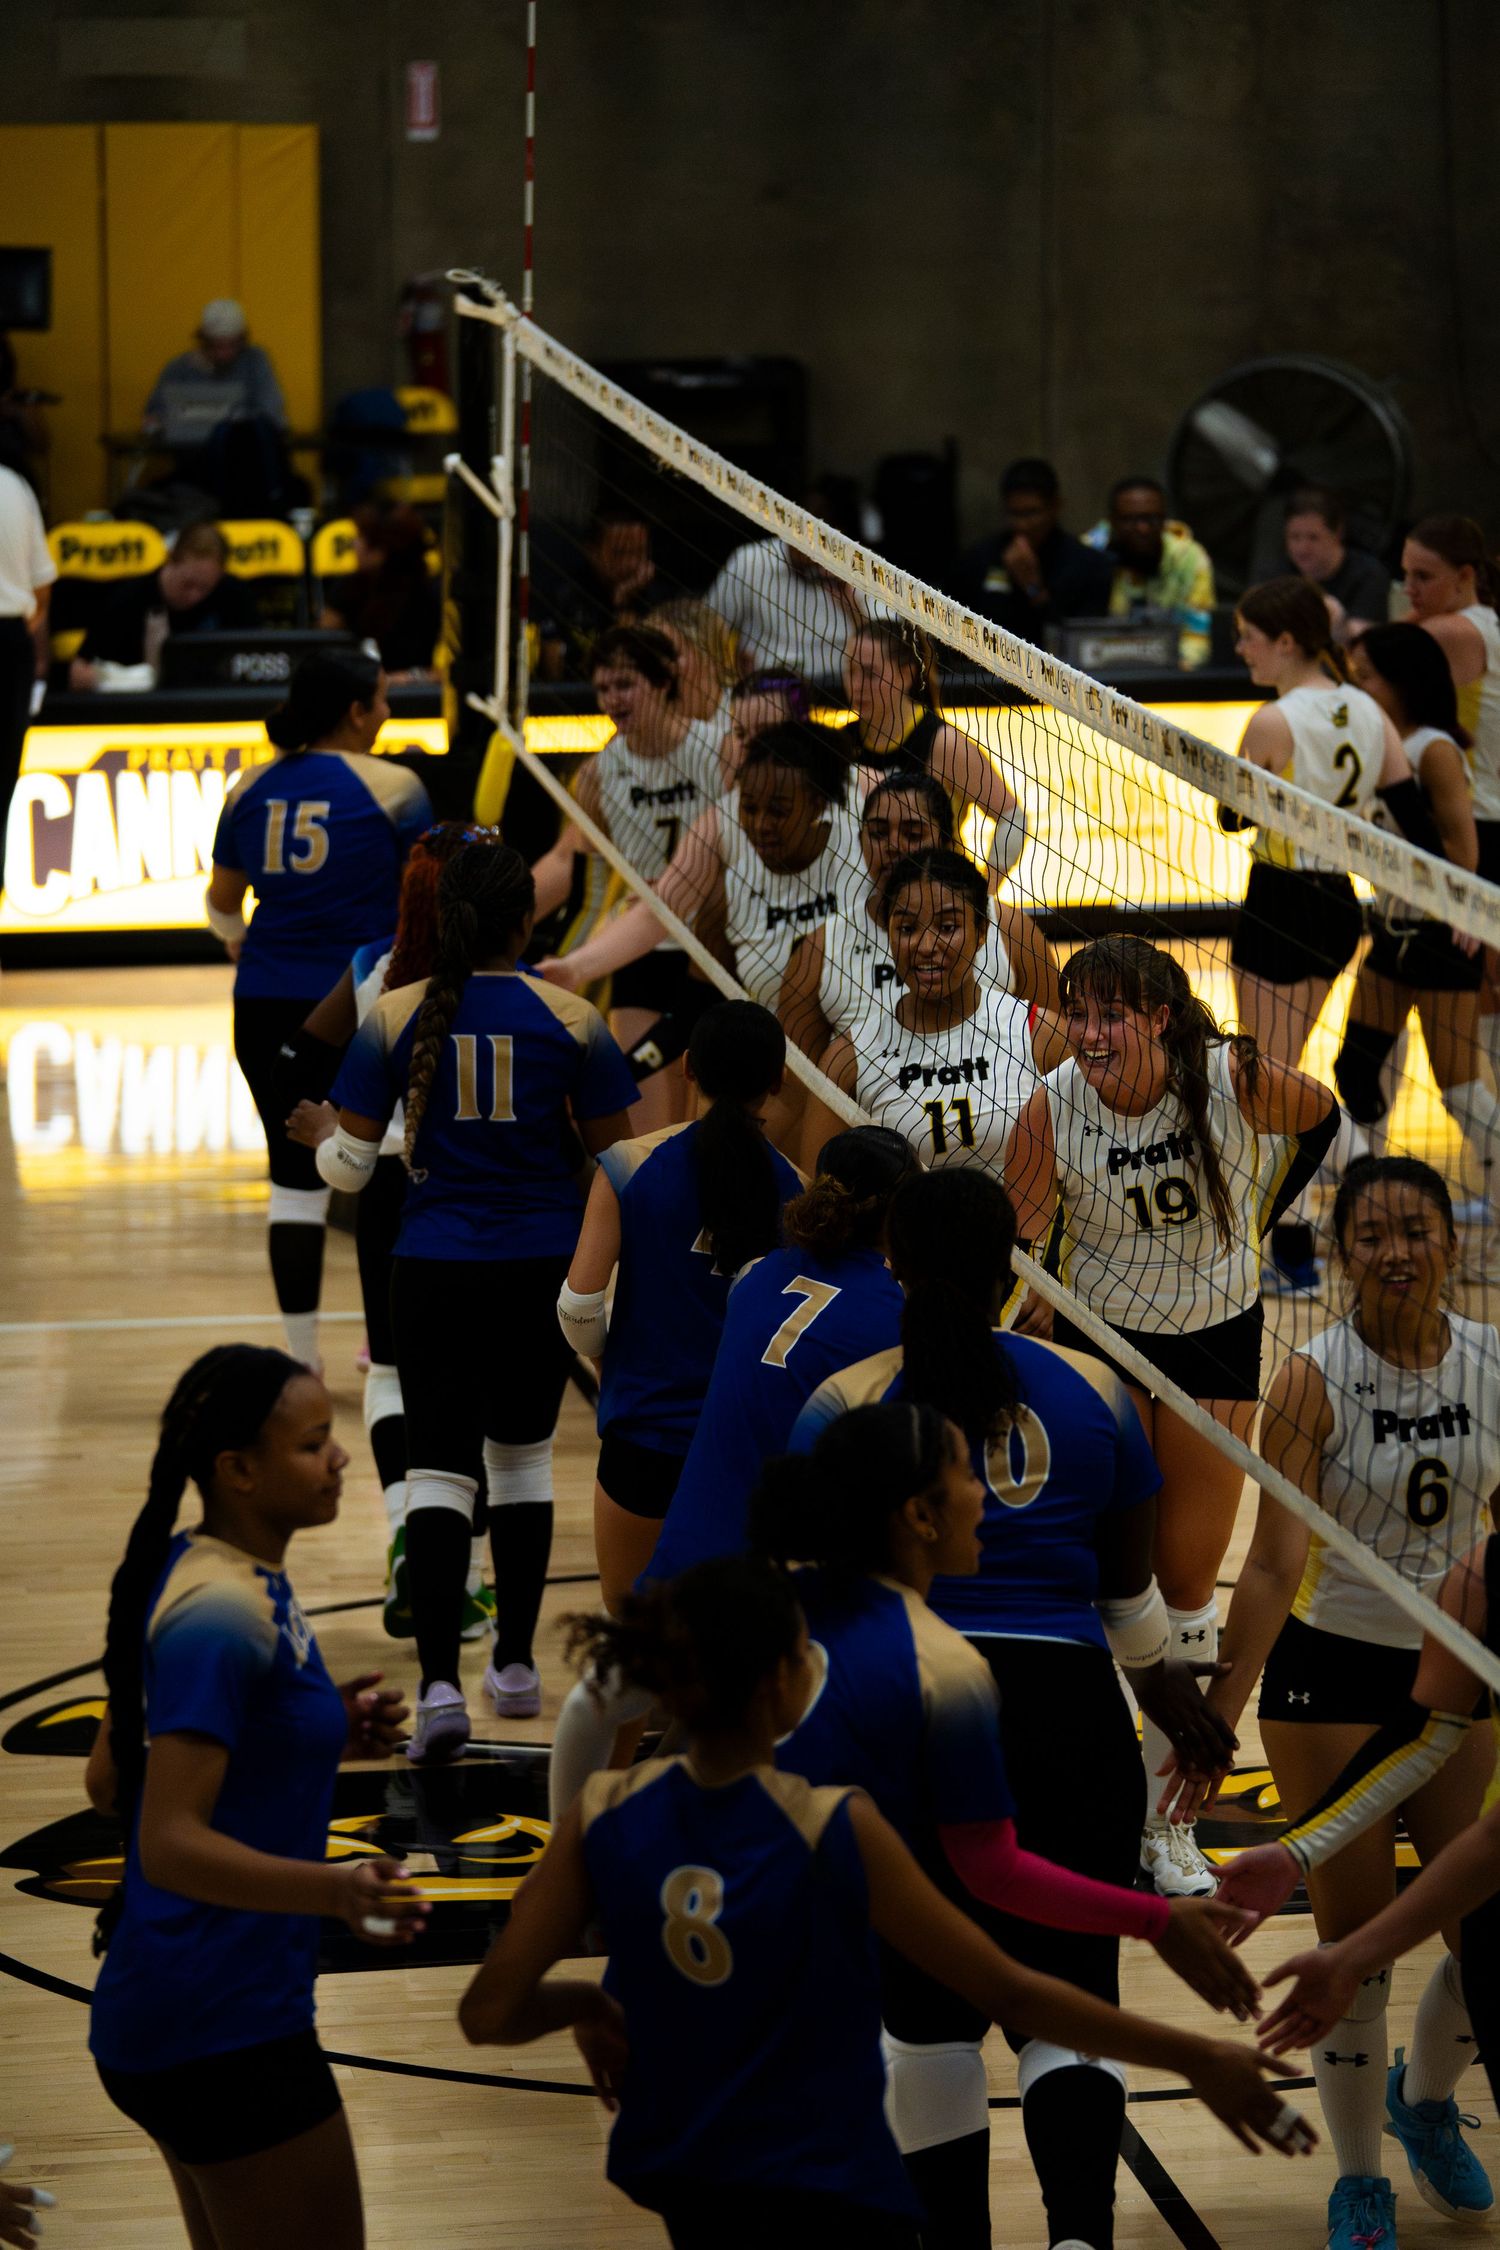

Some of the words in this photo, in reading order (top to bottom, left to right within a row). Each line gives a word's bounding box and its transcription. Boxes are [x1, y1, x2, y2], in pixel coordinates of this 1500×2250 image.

[59, 537, 146, 564] Pratt
[230, 652, 290, 680] POSS
[631, 780, 695, 808] Pratt
[1334, 742, 1362, 807] 2
[262, 798, 331, 876] 15
[655, 816, 680, 864] 7
[767, 893, 837, 930] Pratt
[453, 1033, 518, 1123] 11
[898, 1056, 990, 1090] Pratt
[924, 1098, 975, 1155] 11
[1108, 1131, 1194, 1175] Pratt
[1126, 1177, 1199, 1230] 19
[760, 1274, 842, 1369] 7
[1373, 1402, 1470, 1444] Pratt
[983, 1401, 1052, 1510] 0
[1406, 1458, 1449, 1528] 6
[659, 1863, 736, 1990] 8
